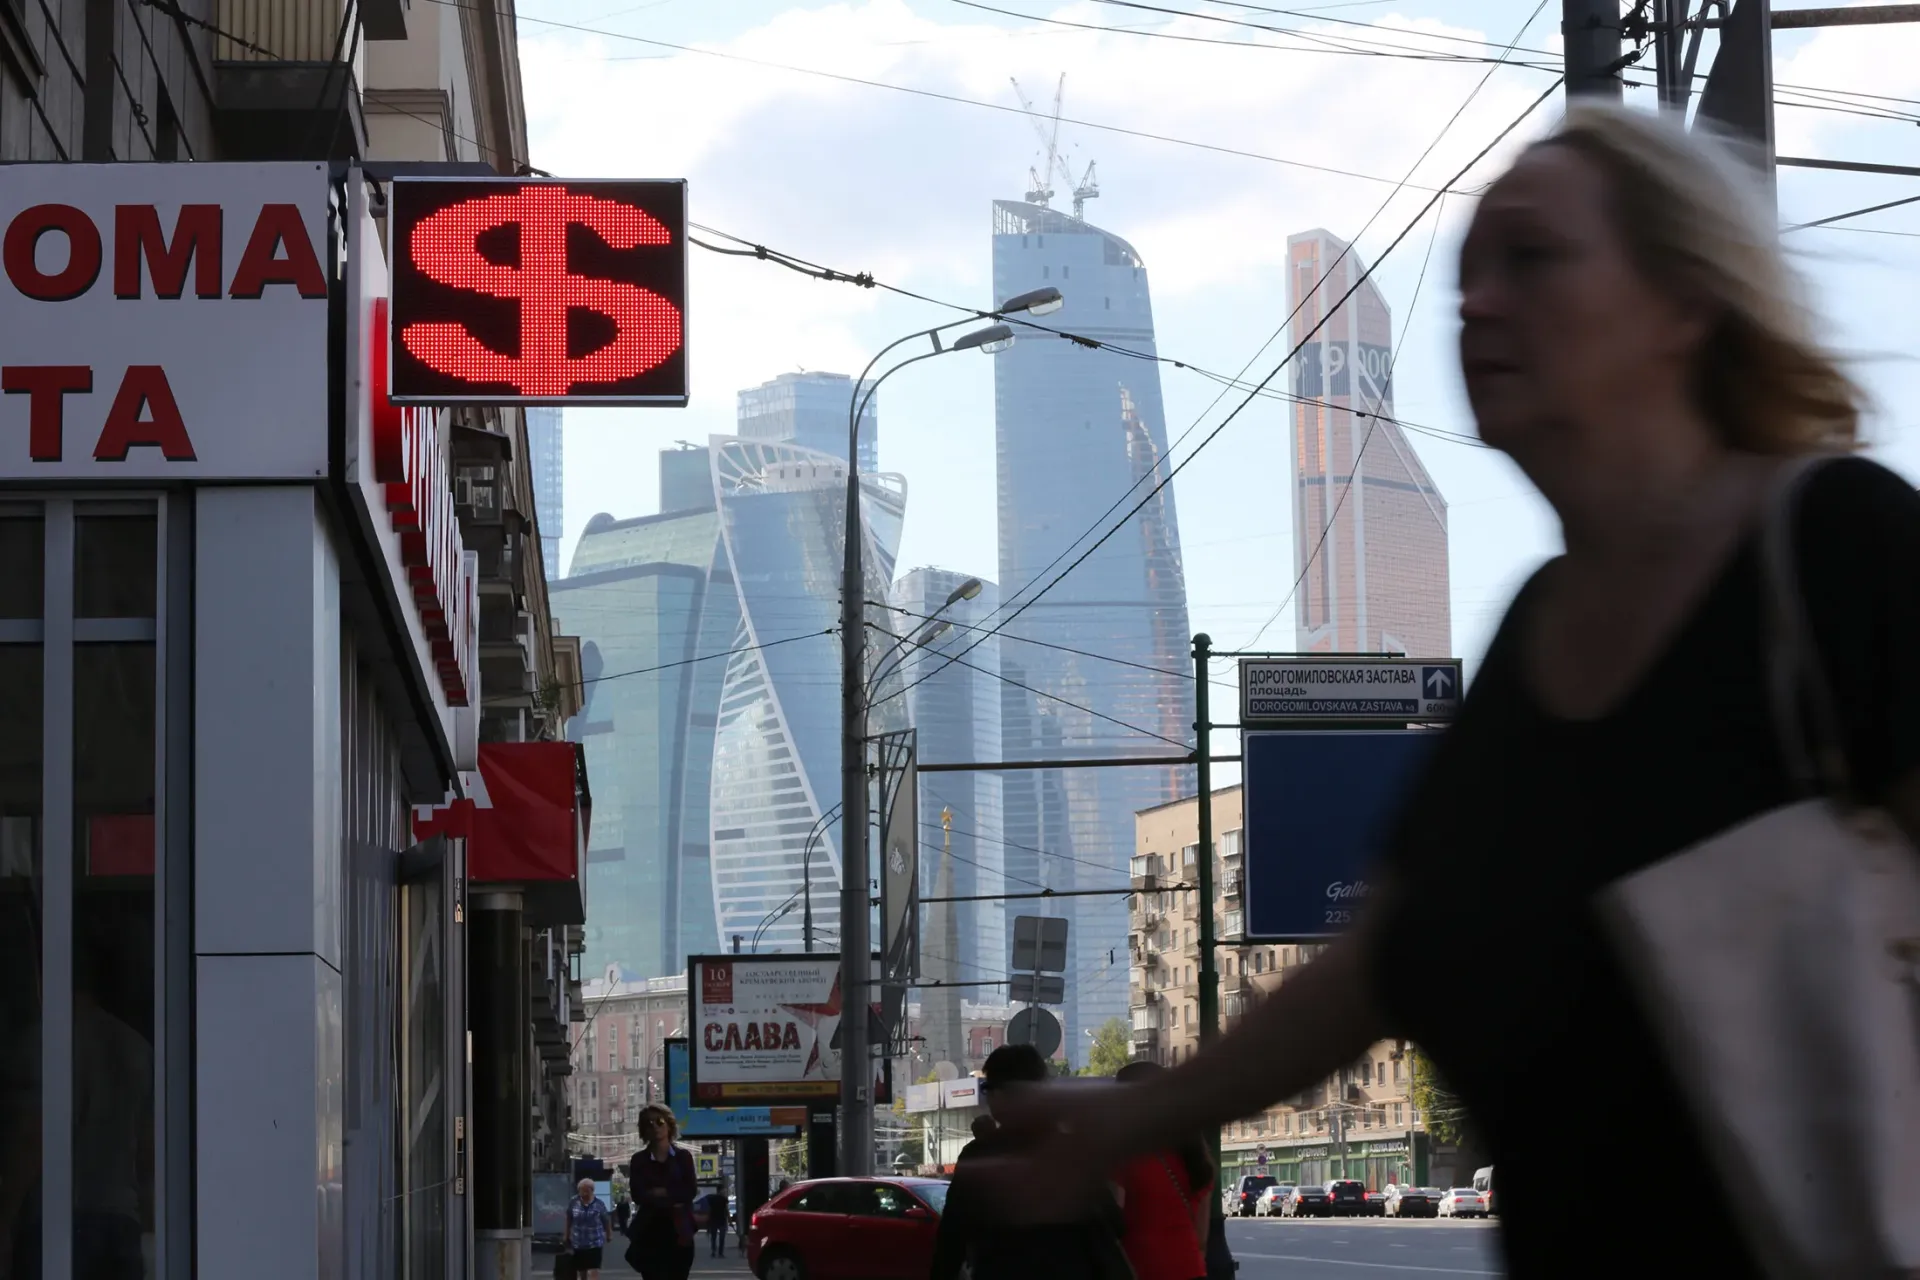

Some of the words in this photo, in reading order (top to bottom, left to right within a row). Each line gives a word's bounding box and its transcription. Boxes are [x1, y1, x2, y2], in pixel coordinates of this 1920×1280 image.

[3, 203, 327, 300] ОМА
[403, 186, 680, 395] $
[2, 365, 197, 461] ТА
[1250, 669, 1363, 685] ДОРОГОМИЛОВСКАЯ
[1366, 669, 1416, 684] ЗАСТАВА
[1250, 687, 1307, 697] площадь
[1252, 701, 1358, 711] DOROGOMILOVSKAYA
[1360, 701, 1403, 711] ZASTAVA
[709, 968, 726, 981] 10
[704, 1021, 801, 1051] СЛАВА
